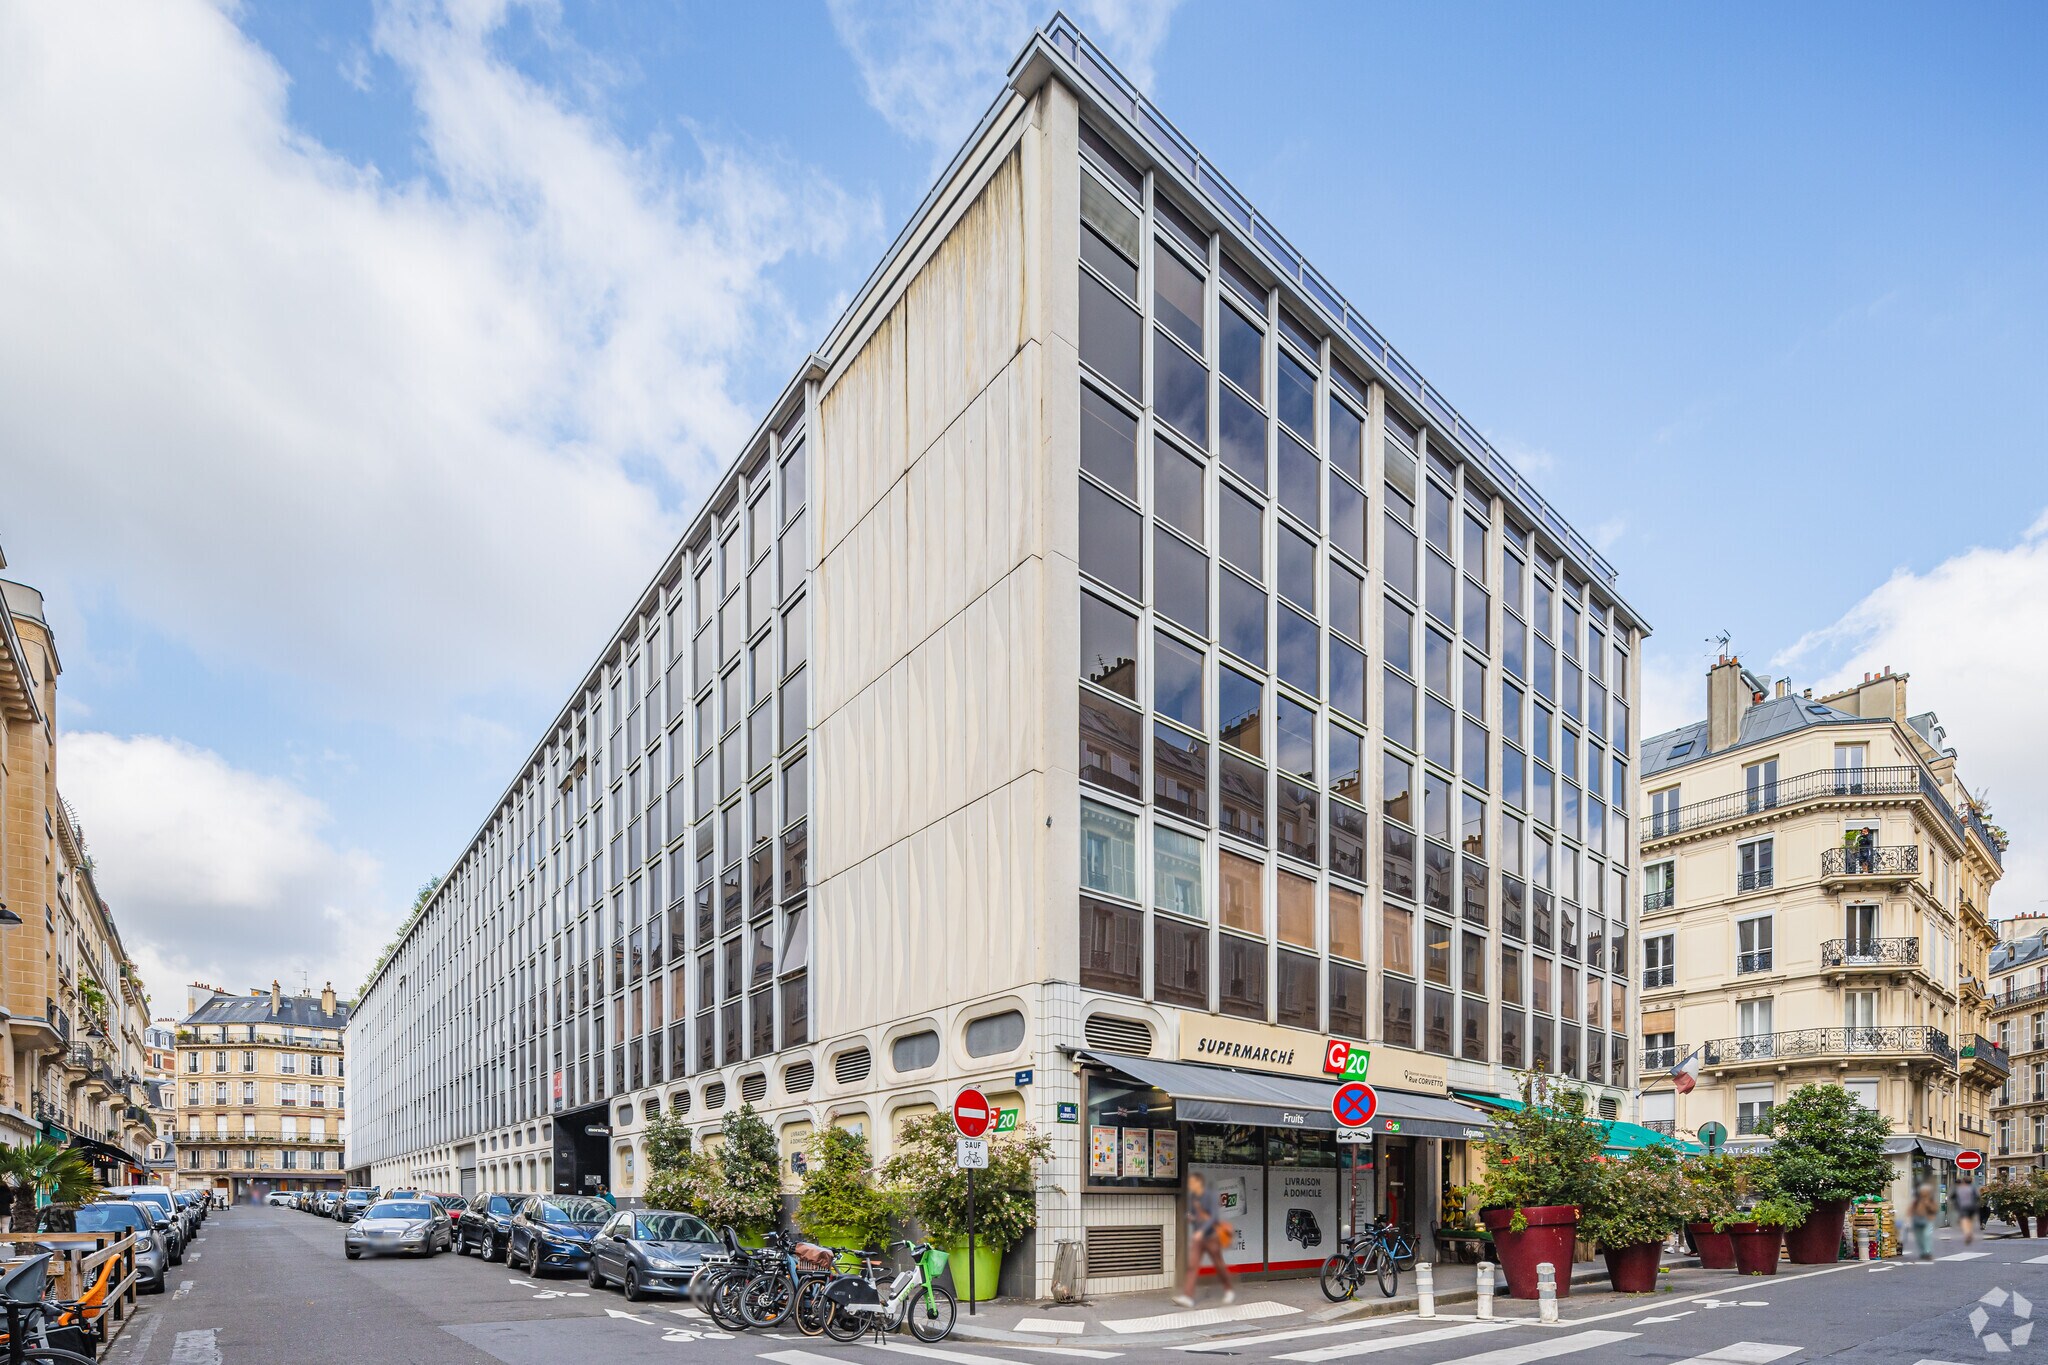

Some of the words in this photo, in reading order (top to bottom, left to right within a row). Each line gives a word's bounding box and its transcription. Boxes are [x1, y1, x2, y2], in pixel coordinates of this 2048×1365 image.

[1198, 1038, 1295, 1065] SUPERMARCHÉ
[1329, 1043, 1368, 1075] G20
[1408, 1076, 1418, 1084] Rue
[1418, 1077, 1444, 1087] CORVETTO
[1283, 1112, 1304, 1124] Fruits
[1386, 1121, 1400, 1131] G20
[1462, 1127, 1485, 1139] Légumes
[965, 1141, 982, 1149] SAUF
[1285, 1177, 1321, 1186] LIVRAISON
[1284, 1187, 1289, 1198] À
[1290, 1188, 1322, 1198] DOMICILE
[1221, 1194, 1237, 1206] G20
